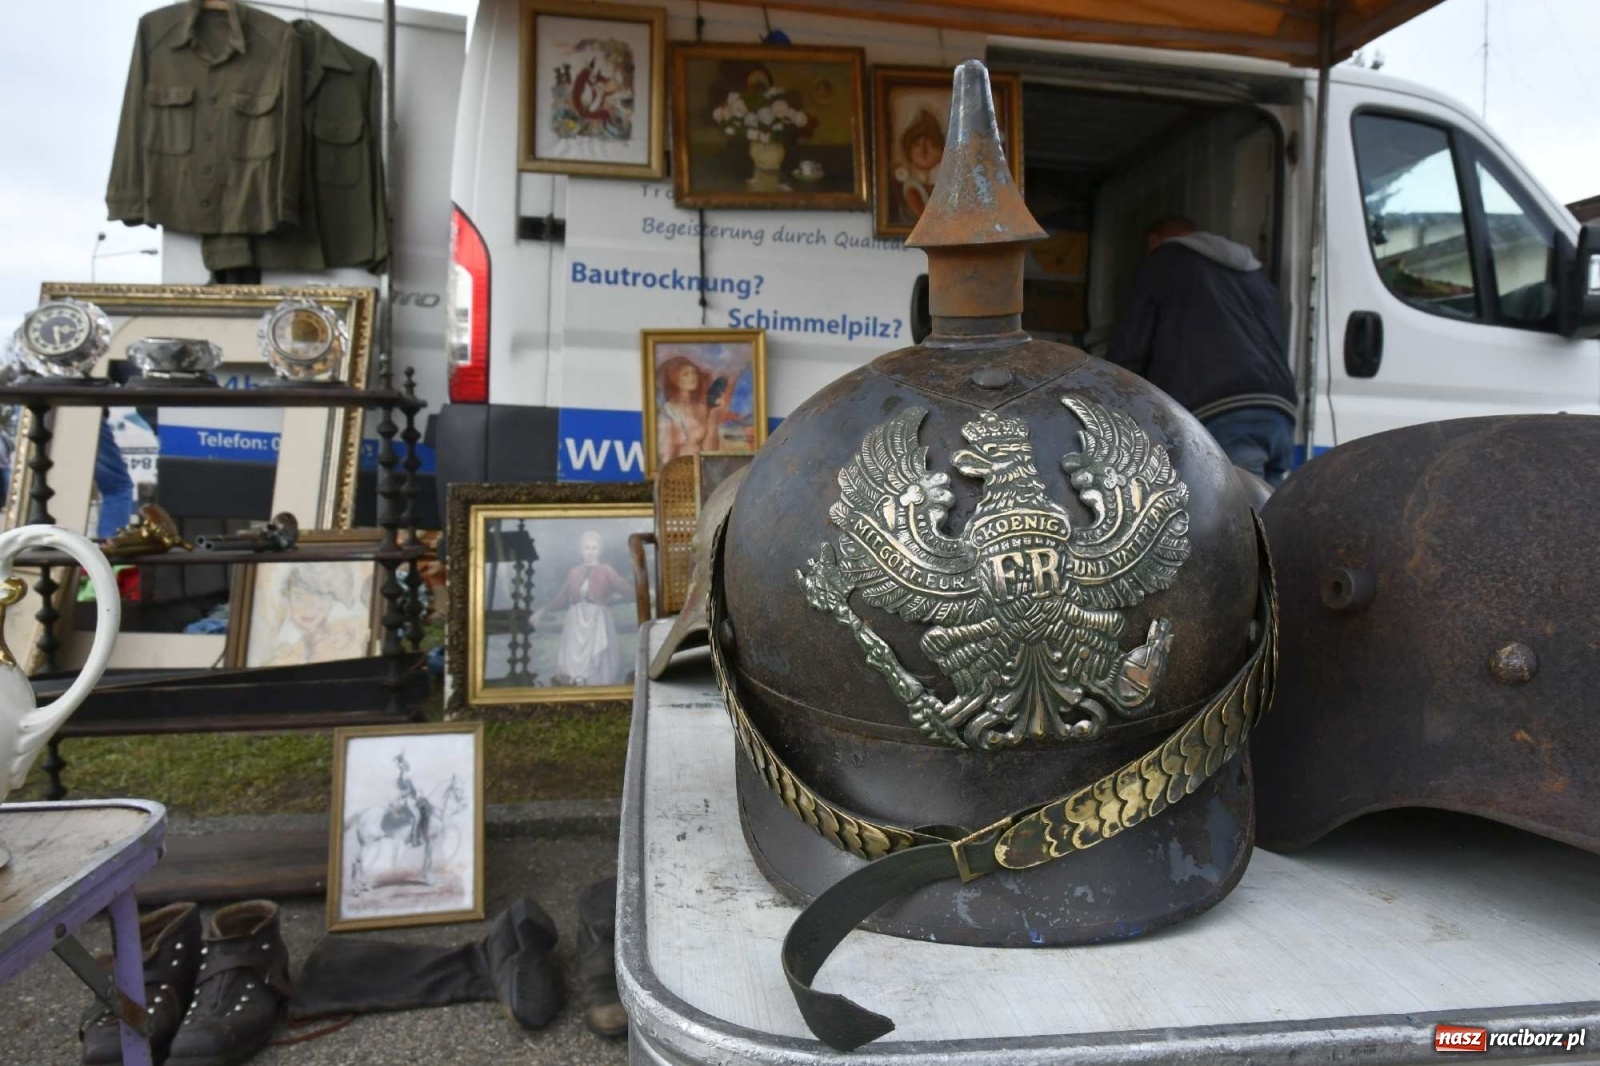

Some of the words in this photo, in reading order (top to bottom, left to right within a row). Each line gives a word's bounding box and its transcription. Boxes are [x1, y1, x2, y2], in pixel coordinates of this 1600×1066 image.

[641, 216, 765, 246] Begeisterung
[772, 226, 826, 246] durch
[571, 262, 765, 300] Bautrocknung?
[728, 308, 903, 341] Schimmelpilz?
[197, 431, 268, 450] Telefon:
[980, 515, 1060, 540] KOENIG
[853, 518, 884, 549] MIT
[879, 545, 922, 580] GOTT
[1073, 558, 1109, 576] UND
